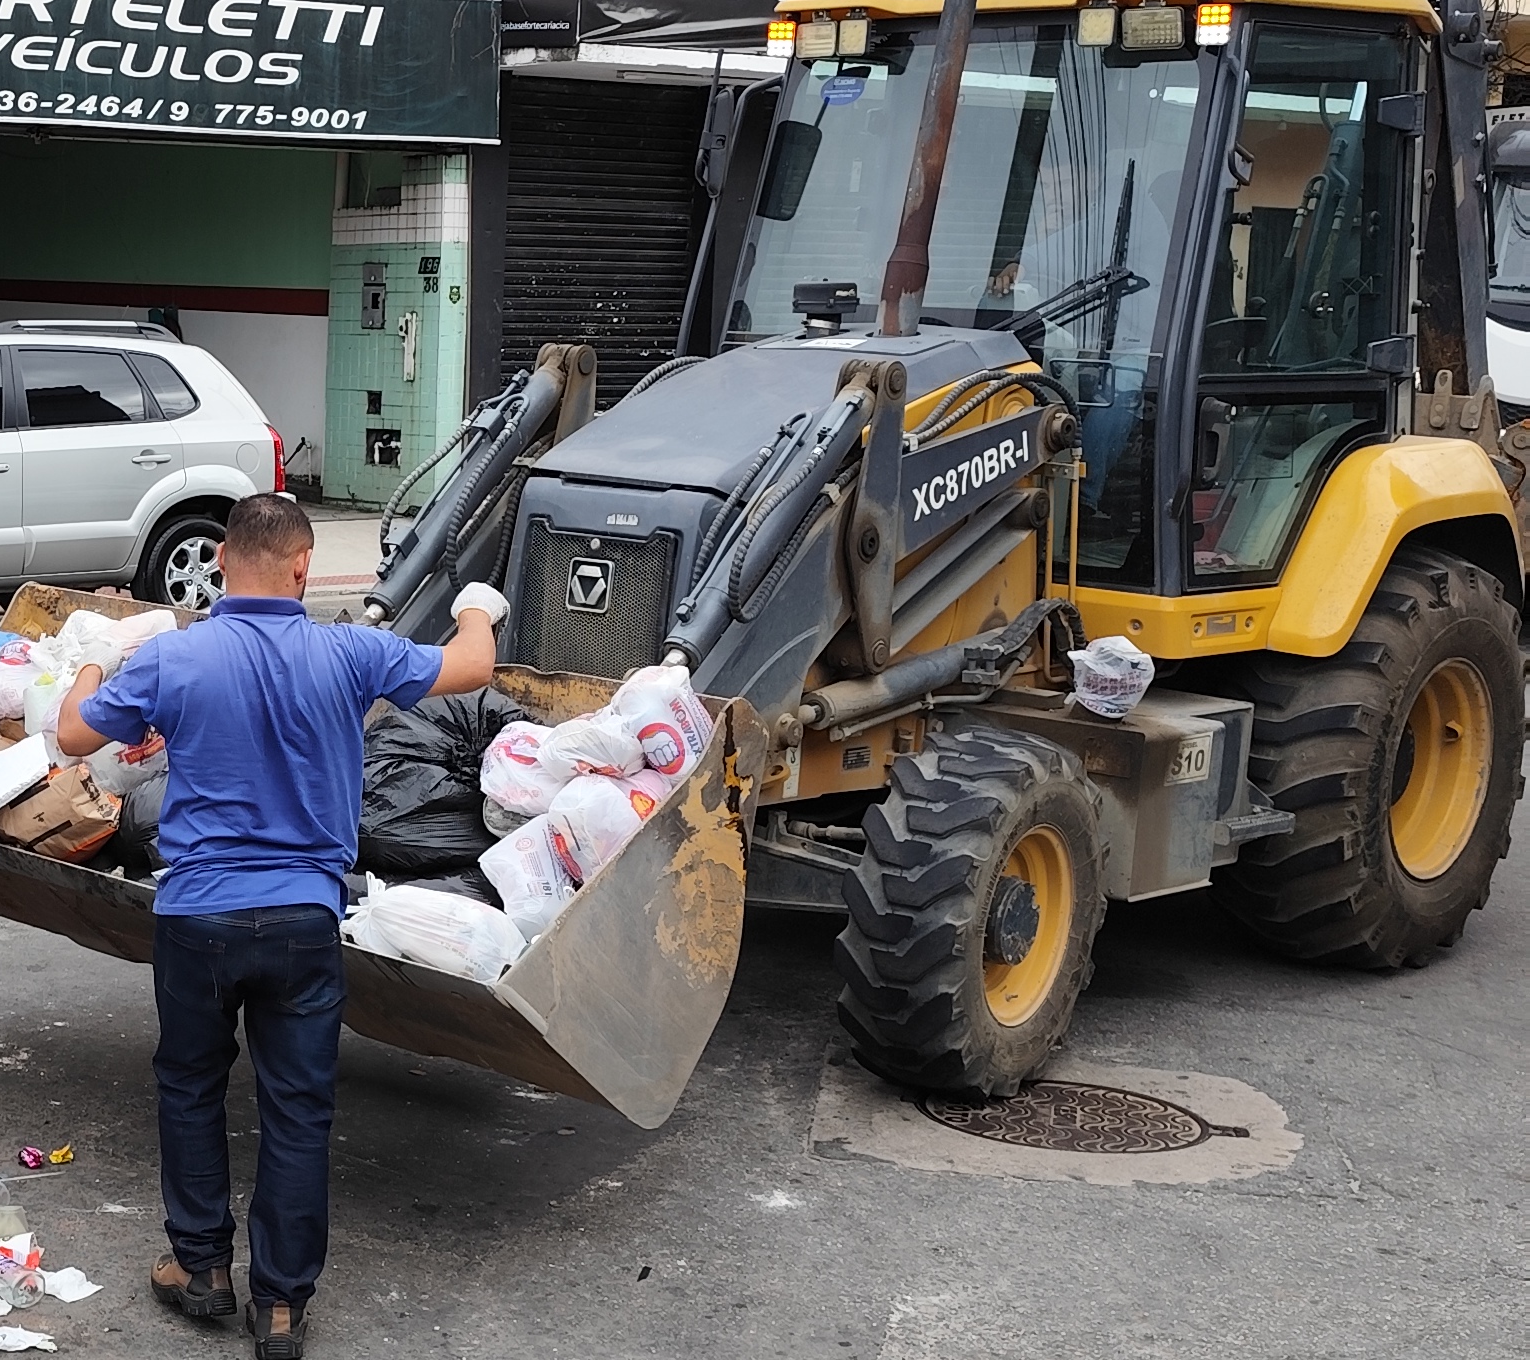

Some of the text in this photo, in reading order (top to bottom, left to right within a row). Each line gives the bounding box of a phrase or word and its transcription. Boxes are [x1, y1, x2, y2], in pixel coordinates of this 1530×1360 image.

[213, 103, 368, 130] 775-9001
[420, 258, 440, 272] 196
[423, 276, 439, 293] 38
[912, 430, 1030, 522] XC870BR-I
[1171, 749, 1205, 776] S10
